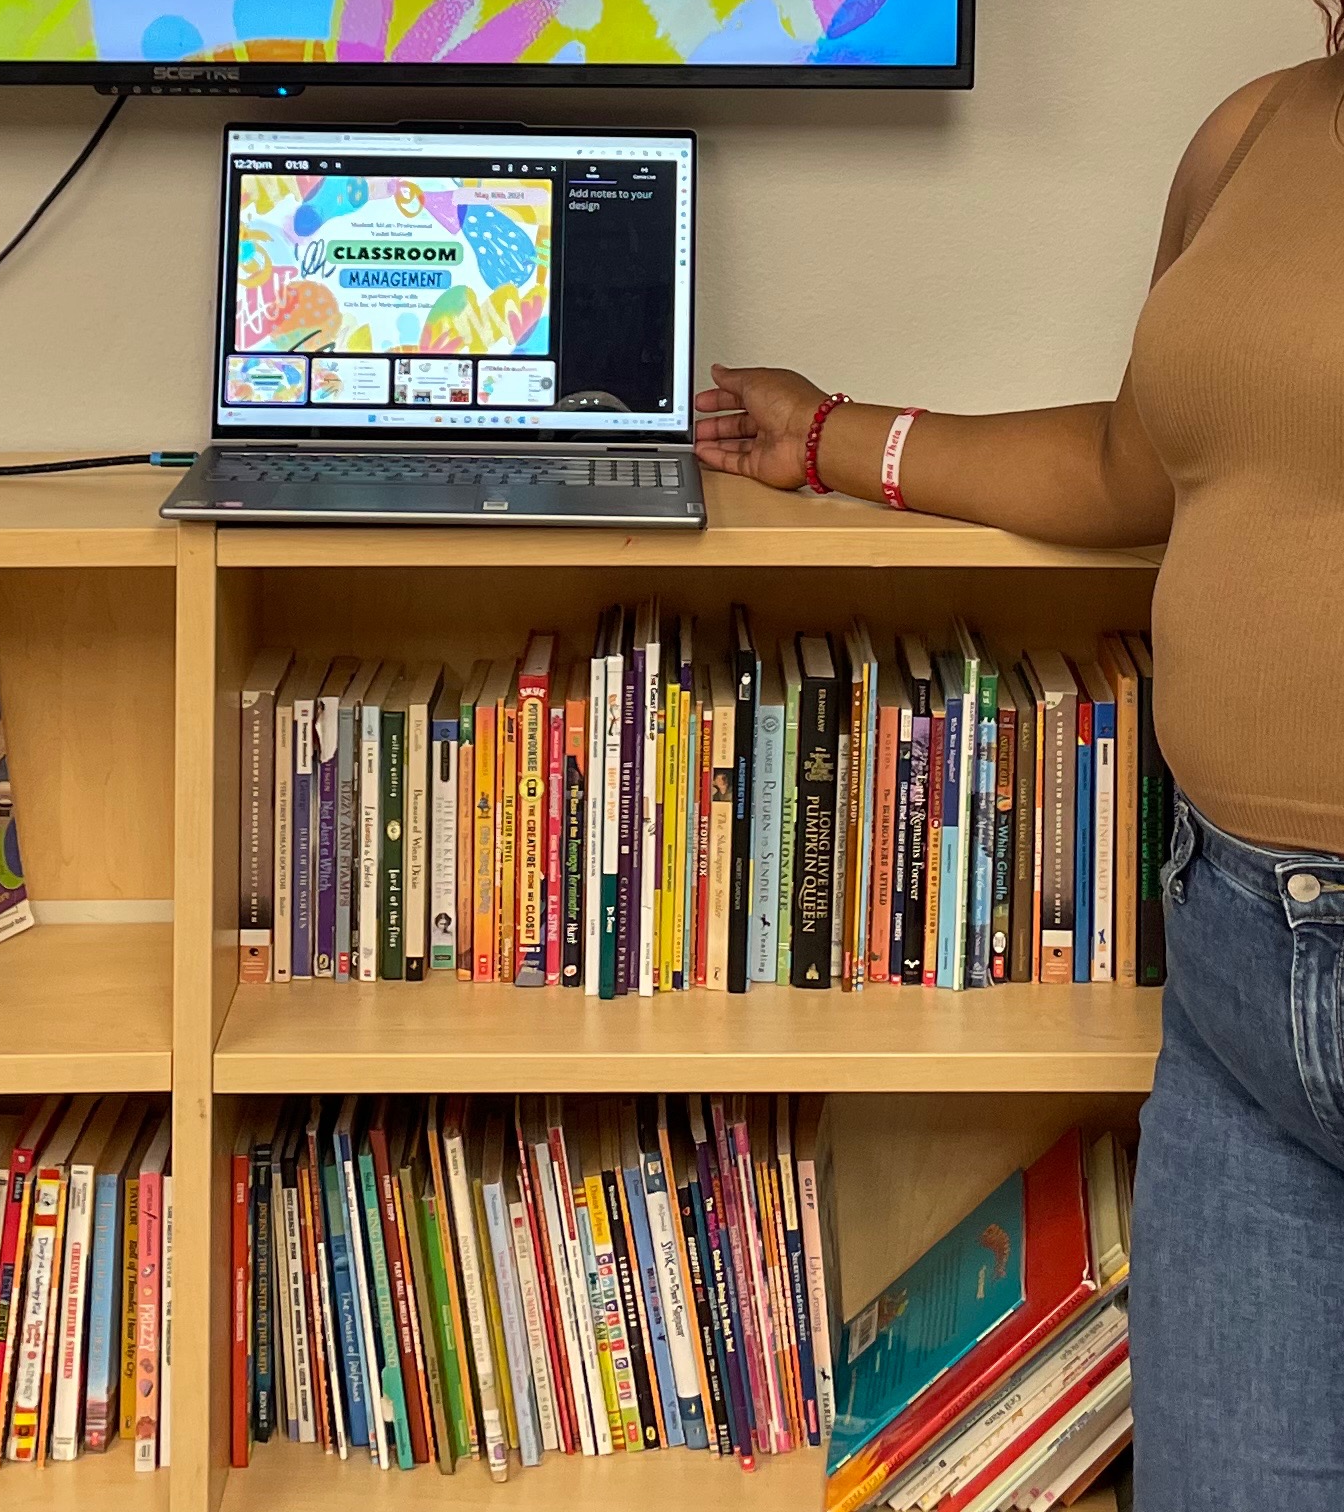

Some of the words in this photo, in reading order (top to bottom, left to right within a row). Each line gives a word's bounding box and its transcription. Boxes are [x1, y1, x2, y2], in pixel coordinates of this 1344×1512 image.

[153, 66, 240, 80] SCEPTRE
[233, 159, 272, 170] 12:21pm
[568, 189, 589, 199] Add
[590, 190, 617, 199] notes
[619, 190, 629, 199] to
[630, 190, 653, 201] your
[568, 201, 600, 212] design
[333, 246, 457, 262] CLASSROOM
[348, 271, 443, 287] MANAGEMENT
[886, 430, 901, 458] Theta
[816, 688, 827, 733] ERNSHAW
[526, 702, 538, 772] POTTERWOOKIEE
[340, 780, 352, 819] KIZZY
[528, 804, 536, 816] THE
[569, 797, 578, 814] Case
[760, 779, 776, 831] RETURN
[340, 822, 352, 852] ANN
[441, 800, 453, 843] HELEN
[569, 816, 578, 825] of
[569, 826, 578, 837] the
[699, 815, 709, 850] STONE
[803, 795, 819, 872] PUMPKIN
[818, 810, 831, 851] LONG
[910, 812, 926, 858] Remains
[525, 819, 537, 868] CREATURE
[566, 838, 582, 873] Teenage
[997, 824, 1009, 858] White
[340, 854, 352, 907] STAMPS
[388, 869, 400, 891] lord
[441, 848, 453, 896] KELLER
[527, 871, 535, 889] FROM
[699, 853, 709, 877] FOX
[759, 853, 775, 904] SENDER
[817, 854, 830, 889] LIVE
[909, 861, 923, 901] Forever
[996, 861, 1008, 901] Giraffe
[389, 896, 399, 908] of
[568, 874, 580, 920] Terminator
[618, 876, 630, 941] CAPSTONE
[798, 875, 817, 933] QUEEN
[817, 892, 830, 919] THE
[388, 911, 399, 926] the
[525, 904, 536, 941] CLOSET
[387, 926, 400, 948] flies
[617, 947, 628, 984] PRESS
[803, 1177, 815, 1210] GIFF
[66, 1242, 82, 1295] CHRISTMAS
[807, 1256, 821, 1284] Lily's
[340, 1291, 353, 1310] The
[617, 1255, 637, 1328] LOCOMOTION
[65, 1298, 80, 1340] BEDTIME
[808, 1286, 824, 1333] Crossing
[342, 1313, 356, 1344] Music
[63, 1342, 78, 1380] STORIES
[346, 1345, 358, 1357] of
[347, 1360, 362, 1403] Dolphins
[533, 1356, 546, 1392] GARY
[539, 1396, 552, 1431] SOTO
[821, 1392, 833, 1437] YEARLING
